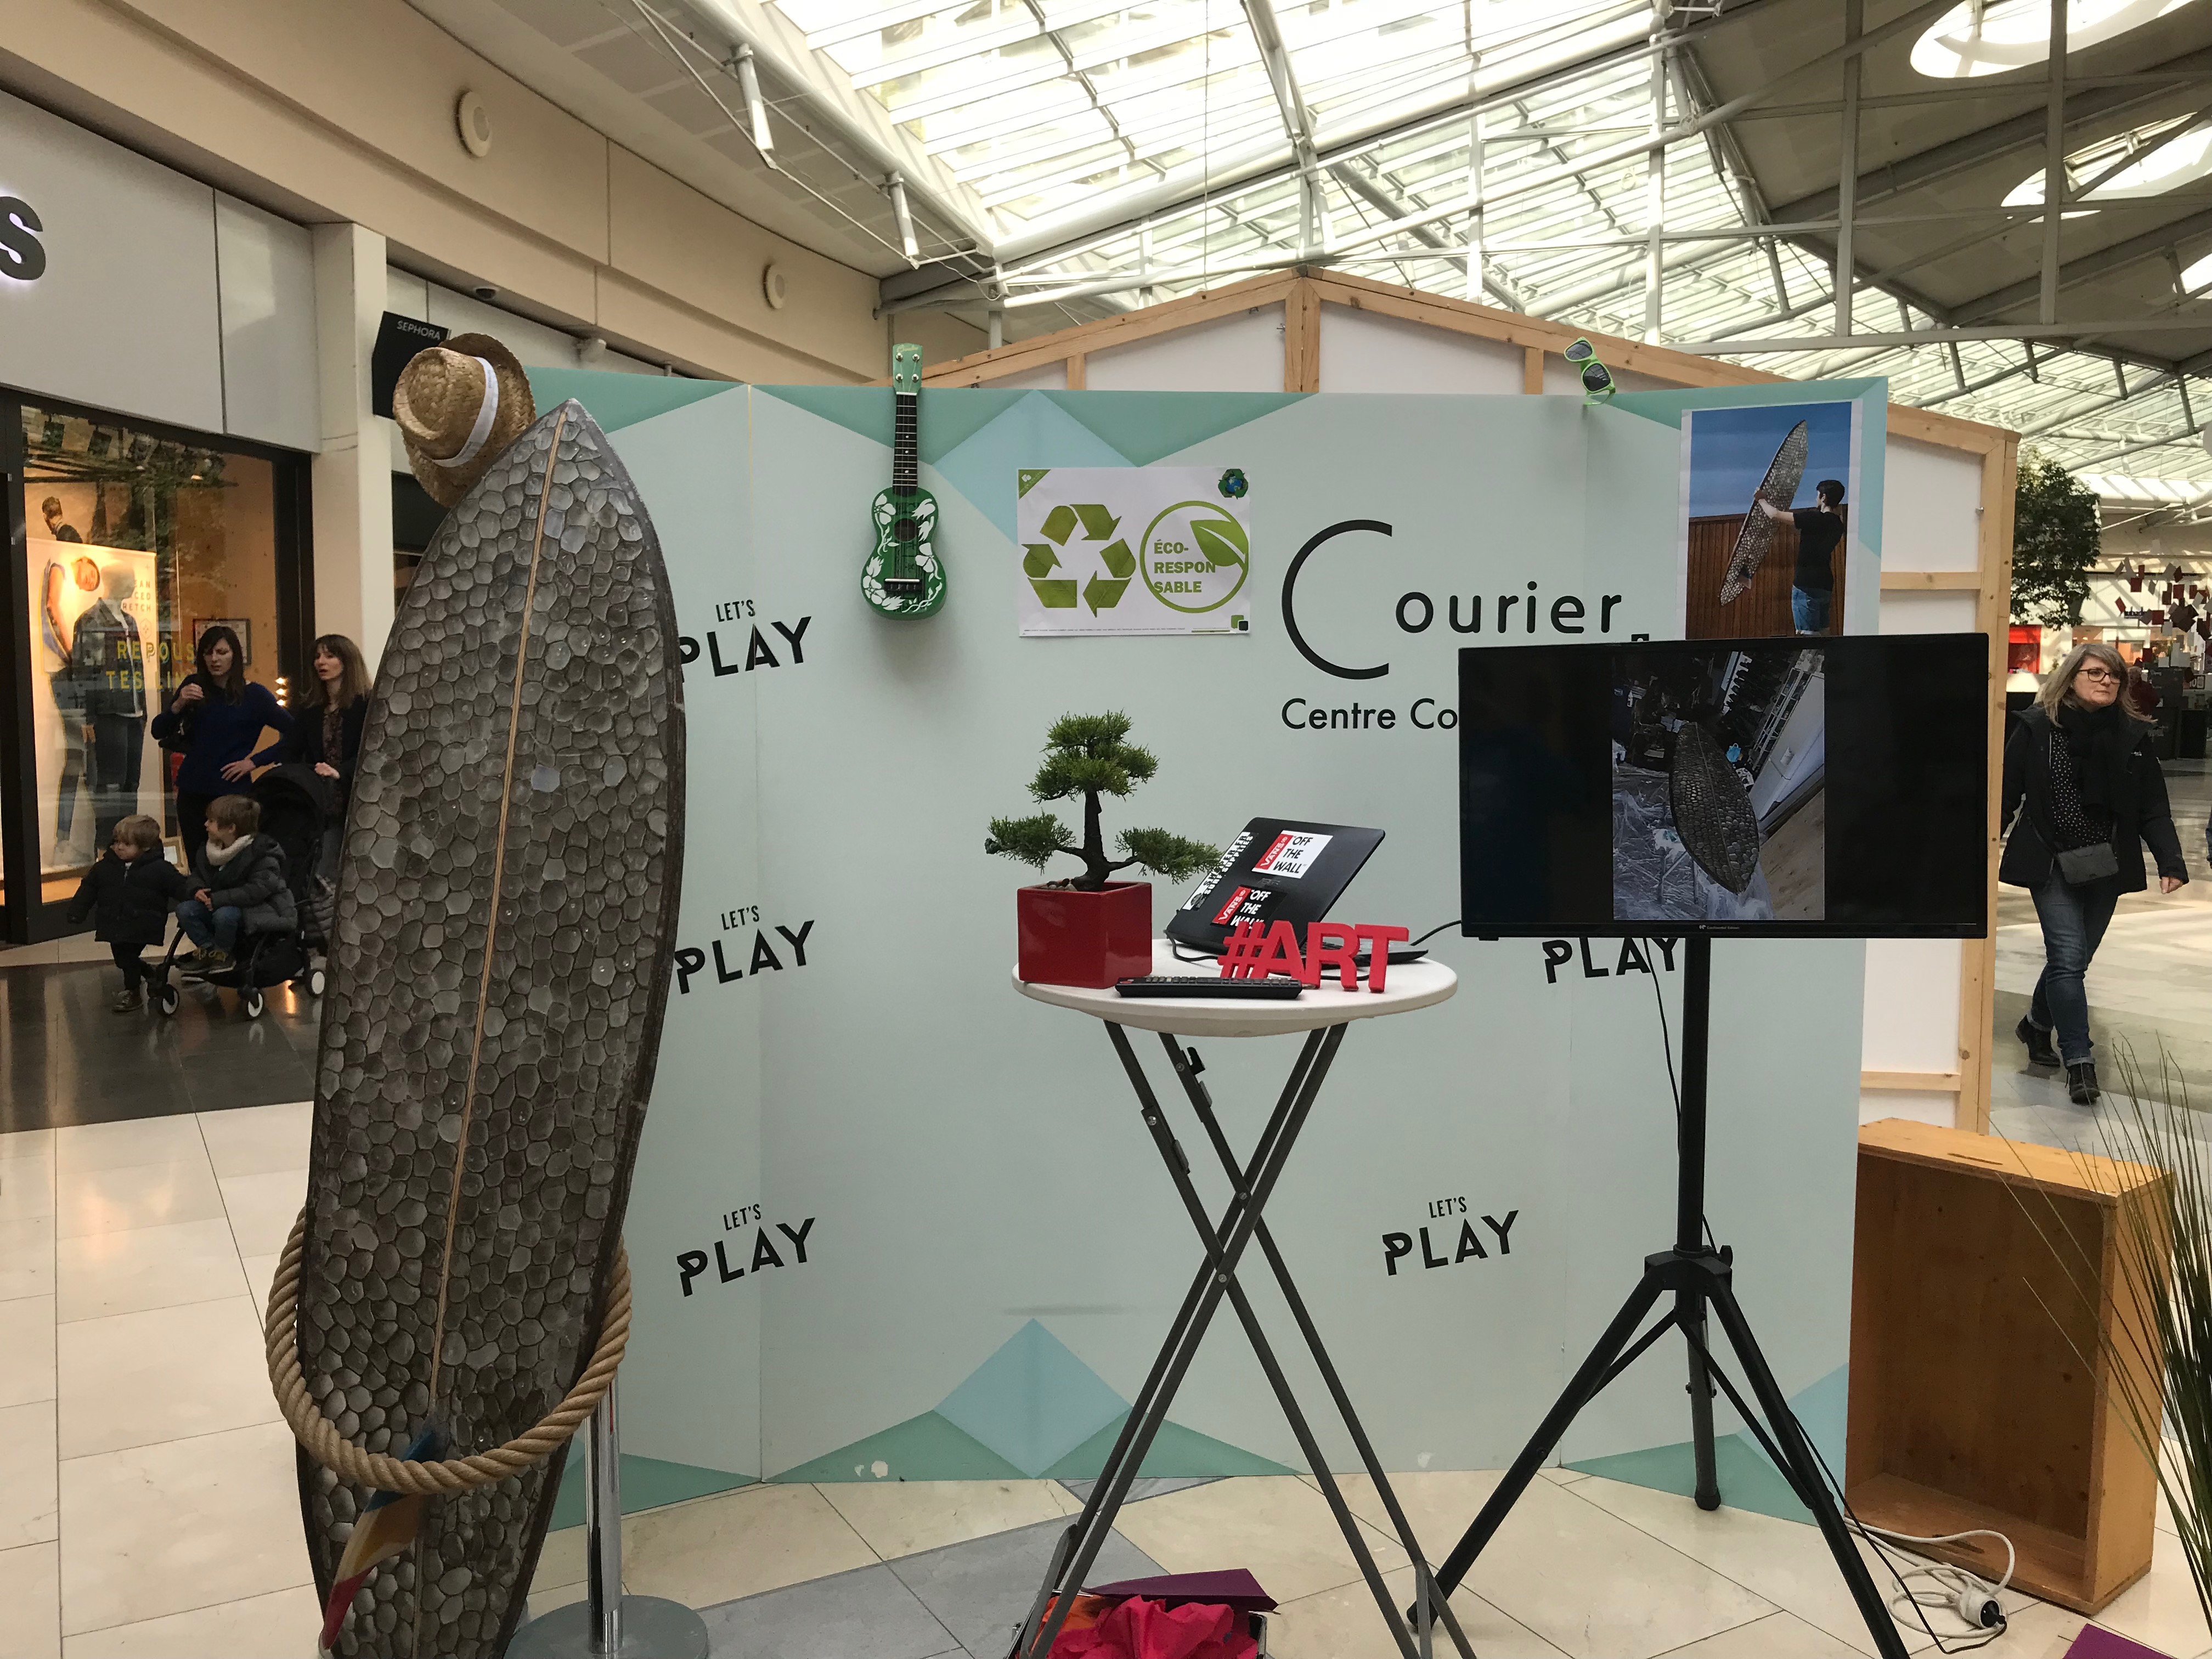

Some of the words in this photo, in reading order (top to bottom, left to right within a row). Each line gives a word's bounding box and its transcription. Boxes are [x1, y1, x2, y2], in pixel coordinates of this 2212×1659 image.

[396, 320, 441, 340] SEPHORA
[1154, 539, 1189, 554] ÉCO-
[1154, 561, 1216, 574] RESPON
[1154, 581, 1202, 594] SABLE
[1282, 520, 1622, 680] Courier
[715, 599, 755, 622] LET'S
[679, 616, 812, 684] PLAY
[105, 670, 144, 691] TES
[1282, 697, 1396, 730] Centre
[1204, 873, 1223, 895] SURF
[1221, 836, 1254, 873] SUPPLIES
[1283, 848, 1304, 859] THE
[721, 905, 760, 930] LET'S
[1240, 902, 1262, 915] THE
[674, 920, 815, 995] PLAY
[1217, 920, 1409, 994] #ART
[1542, 938, 1679, 984] PLAY
[723, 1204, 761, 1231] LET'S
[1429, 1197, 1467, 1218] LET'S
[1382, 1210, 1519, 1276] PLAY
[676, 1217, 816, 1297] PLAY
